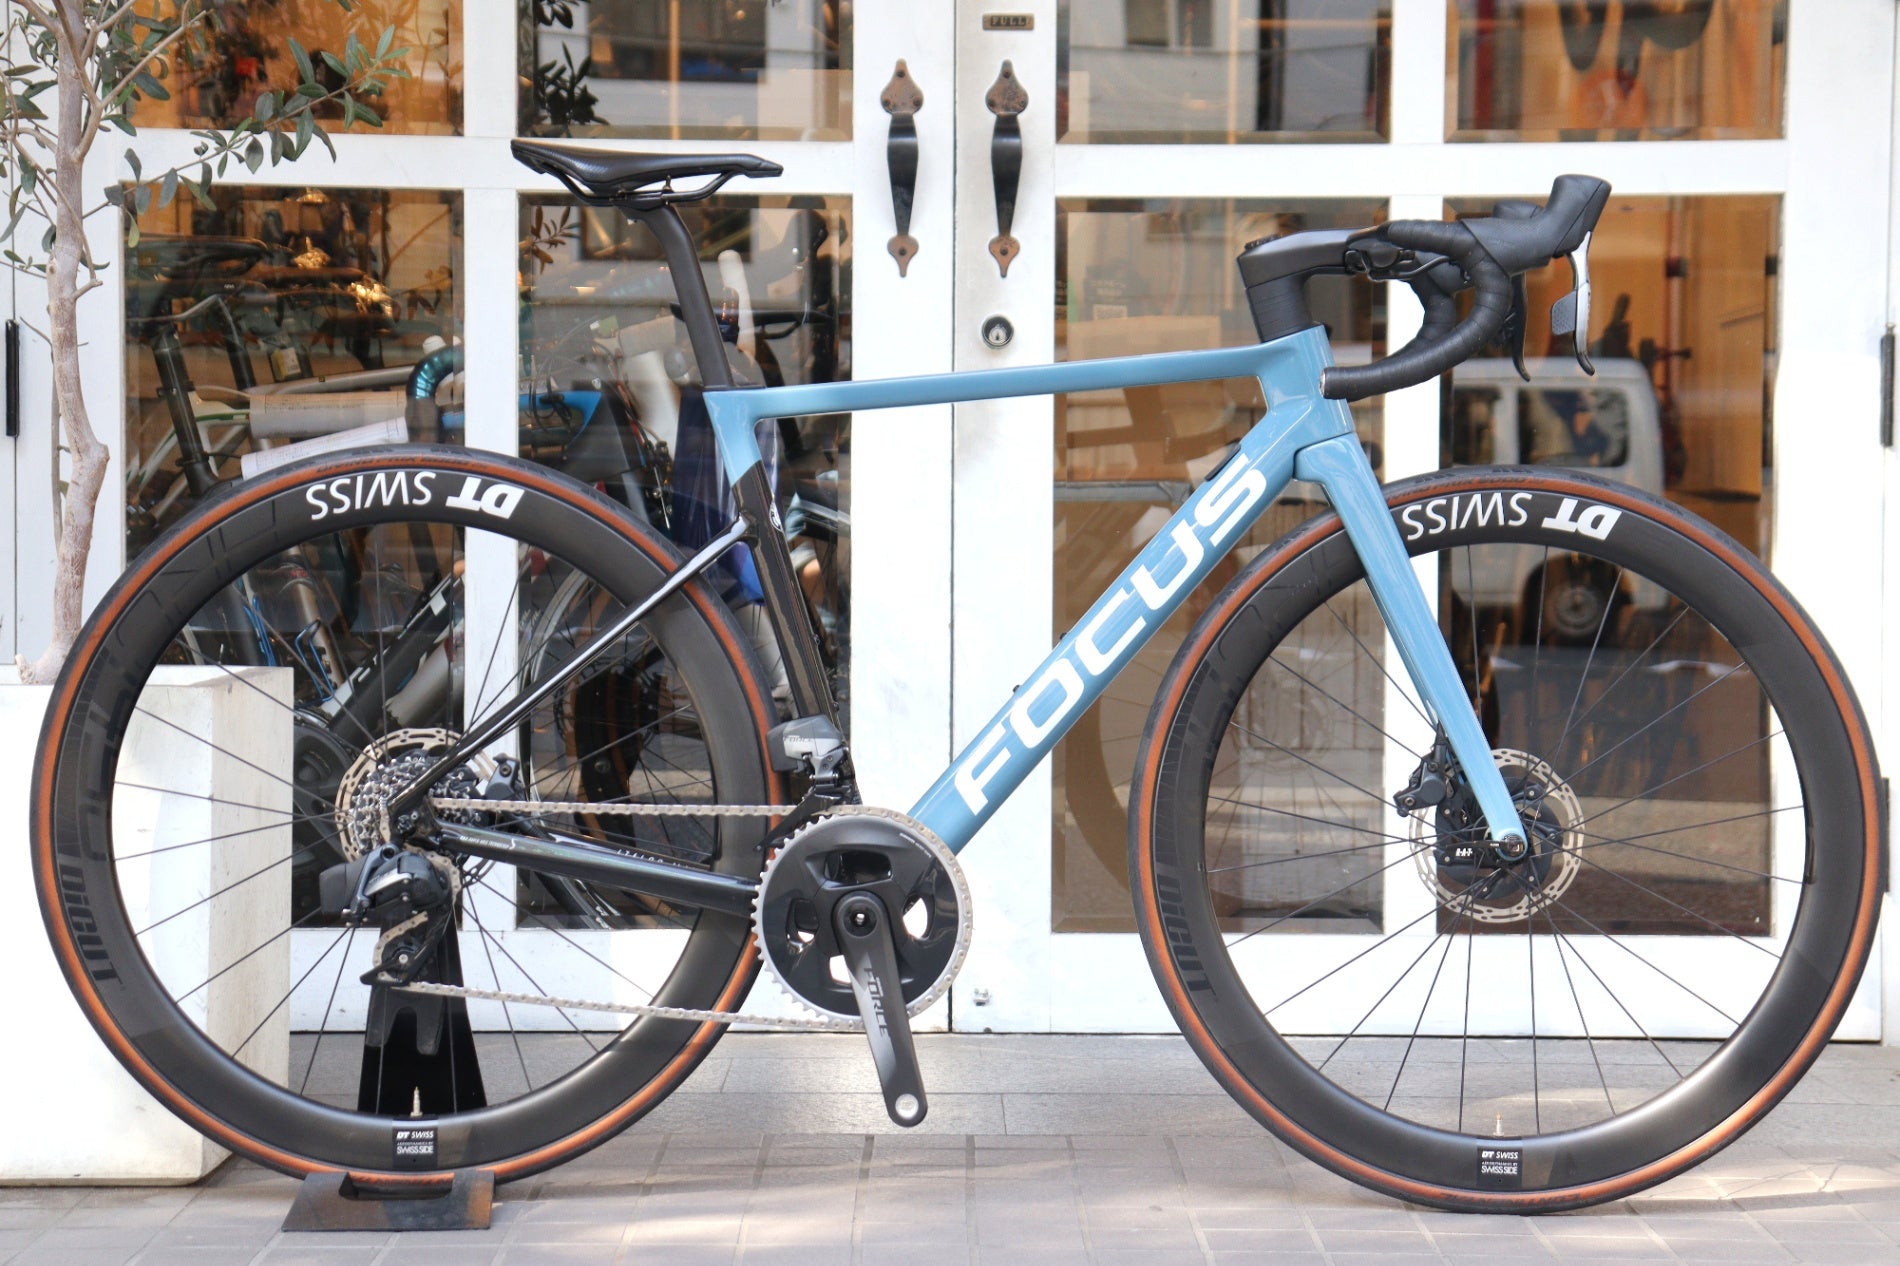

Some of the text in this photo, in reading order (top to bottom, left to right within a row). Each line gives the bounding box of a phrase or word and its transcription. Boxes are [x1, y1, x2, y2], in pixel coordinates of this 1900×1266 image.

[305, 470, 525, 521] DT SWISS
[1402, 492, 1622, 541] DT SWISS
[954, 453, 1267, 816] FOCUS
[396, 1131, 434, 1139] DT SWISS
[1481, 1150, 1519, 1159] DT SWISS
